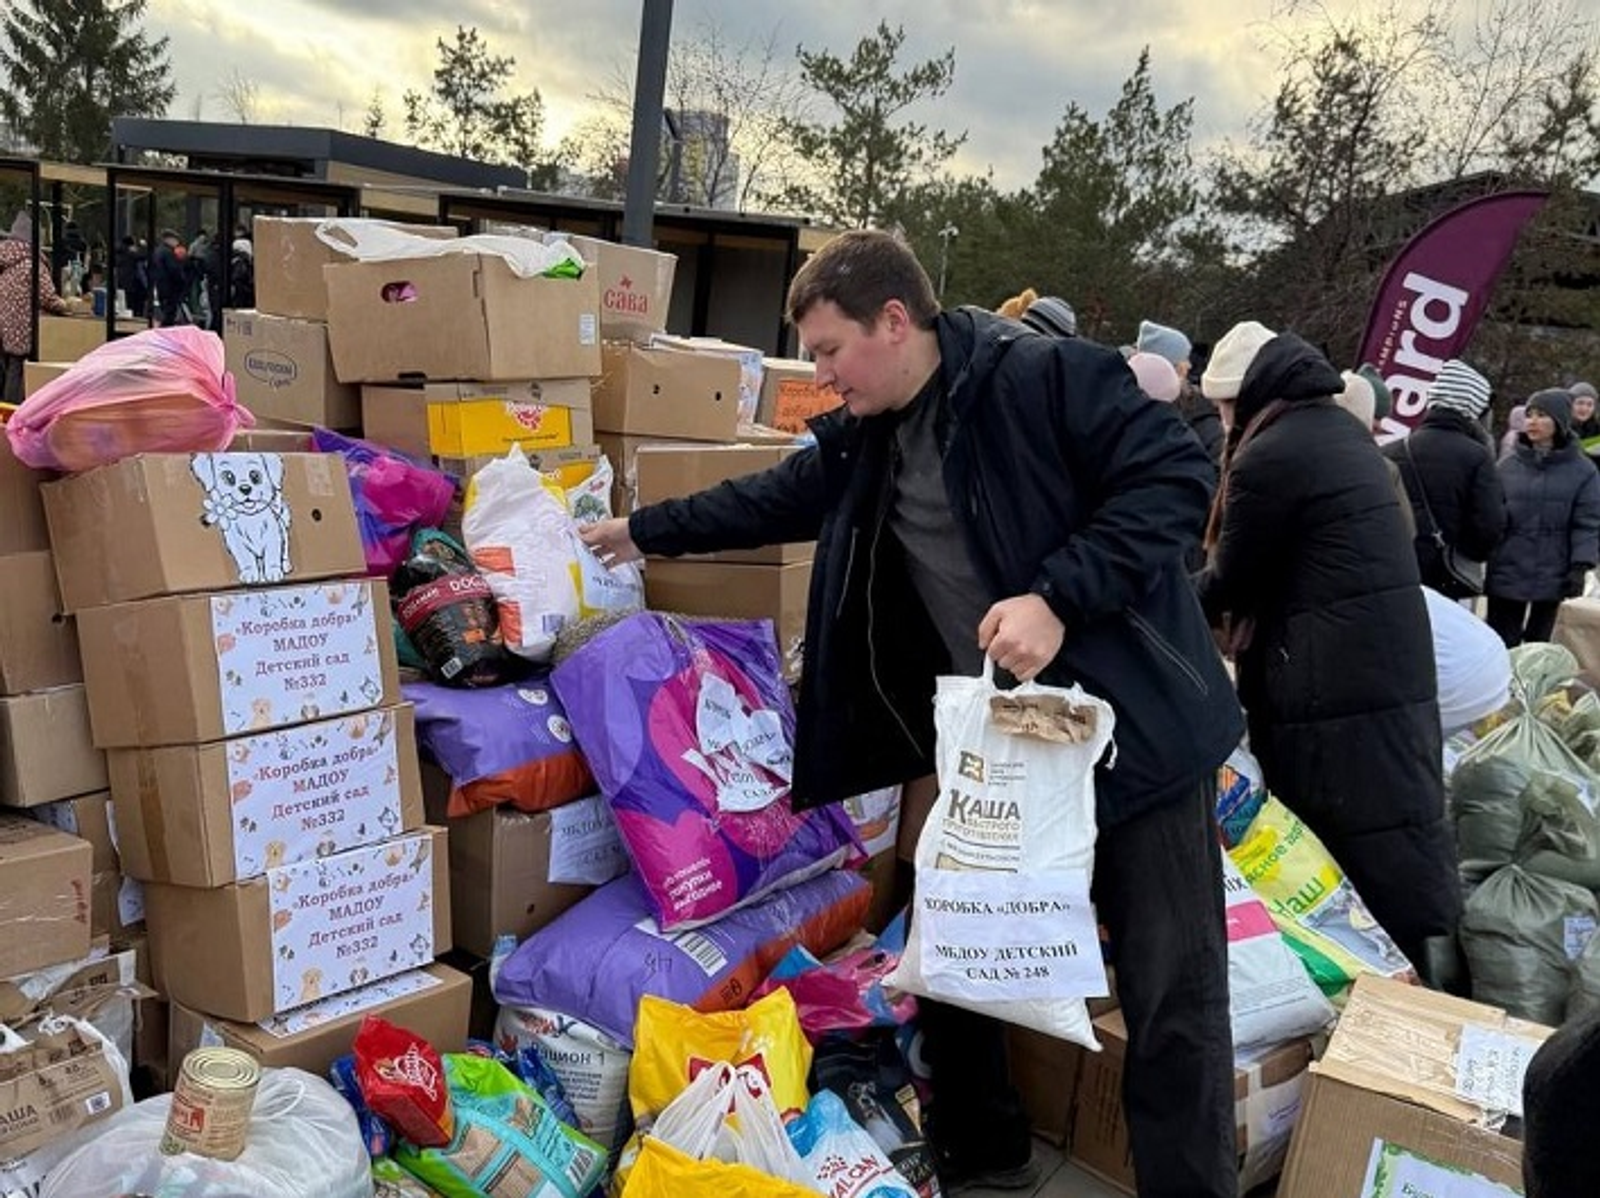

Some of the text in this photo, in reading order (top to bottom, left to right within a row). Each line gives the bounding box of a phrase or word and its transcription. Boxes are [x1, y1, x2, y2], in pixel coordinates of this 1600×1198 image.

[273, 633, 329, 652] МАДОУ
[255, 653, 350, 676] Детский сад
[284, 673, 327, 691] №332
[293, 768, 349, 794] МАДОУ
[272, 785, 370, 820] Детский сад
[301, 808, 345, 831] №332
[329, 895, 384, 921] МАДОУ
[925, 897, 1071, 915] КОРОБКА «ДОБРА»
[308, 913, 404, 948] Детский сад
[336, 935, 378, 959] №332
[935, 939, 1078, 961] МБДОУ ДЕТСКИЙ
[967, 965, 1050, 980] САД № 248
